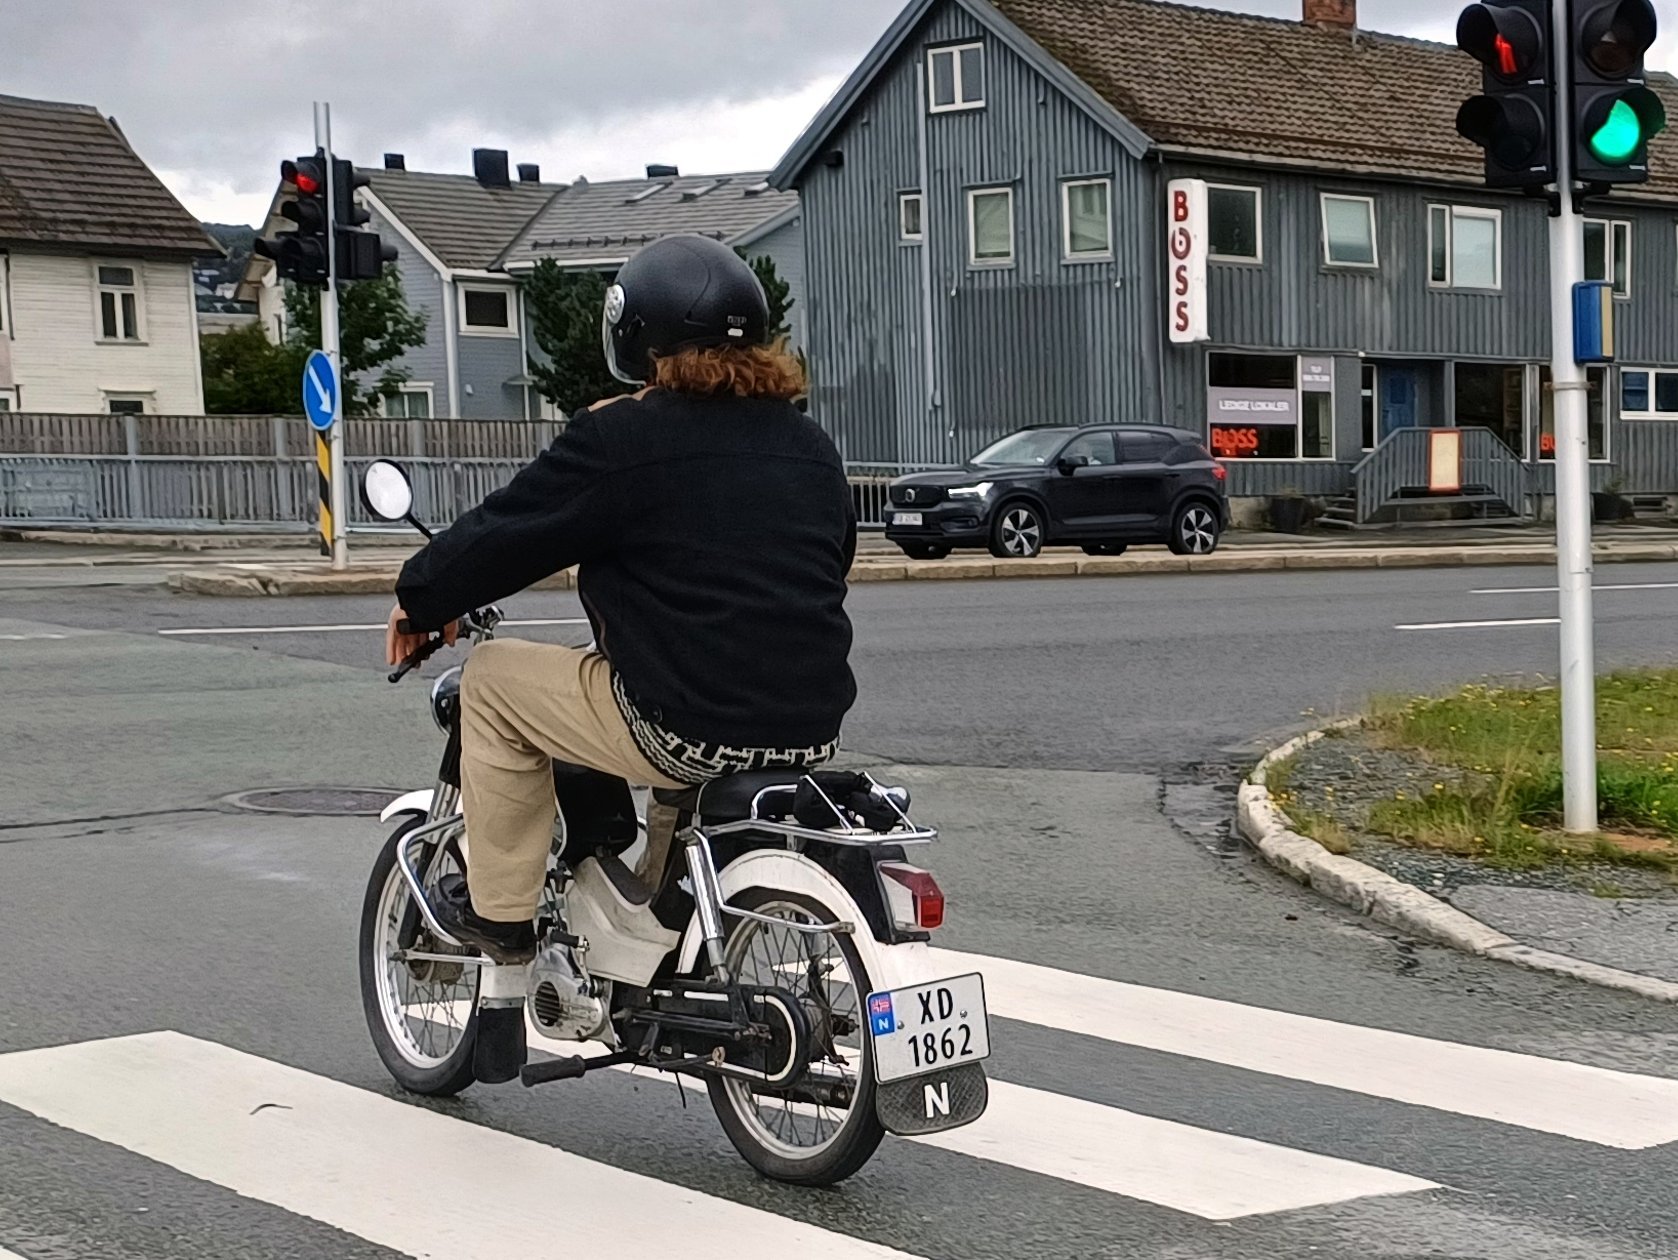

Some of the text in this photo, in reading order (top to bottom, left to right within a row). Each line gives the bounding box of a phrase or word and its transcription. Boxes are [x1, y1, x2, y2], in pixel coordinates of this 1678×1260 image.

[1170, 190, 1191, 332] BOSS
[1211, 428, 1258, 449] BOSS
[878, 1018, 889, 1030] N
[917, 988, 953, 1024] XD
[908, 1024, 973, 1067] 1862
[924, 1082, 950, 1118] N
